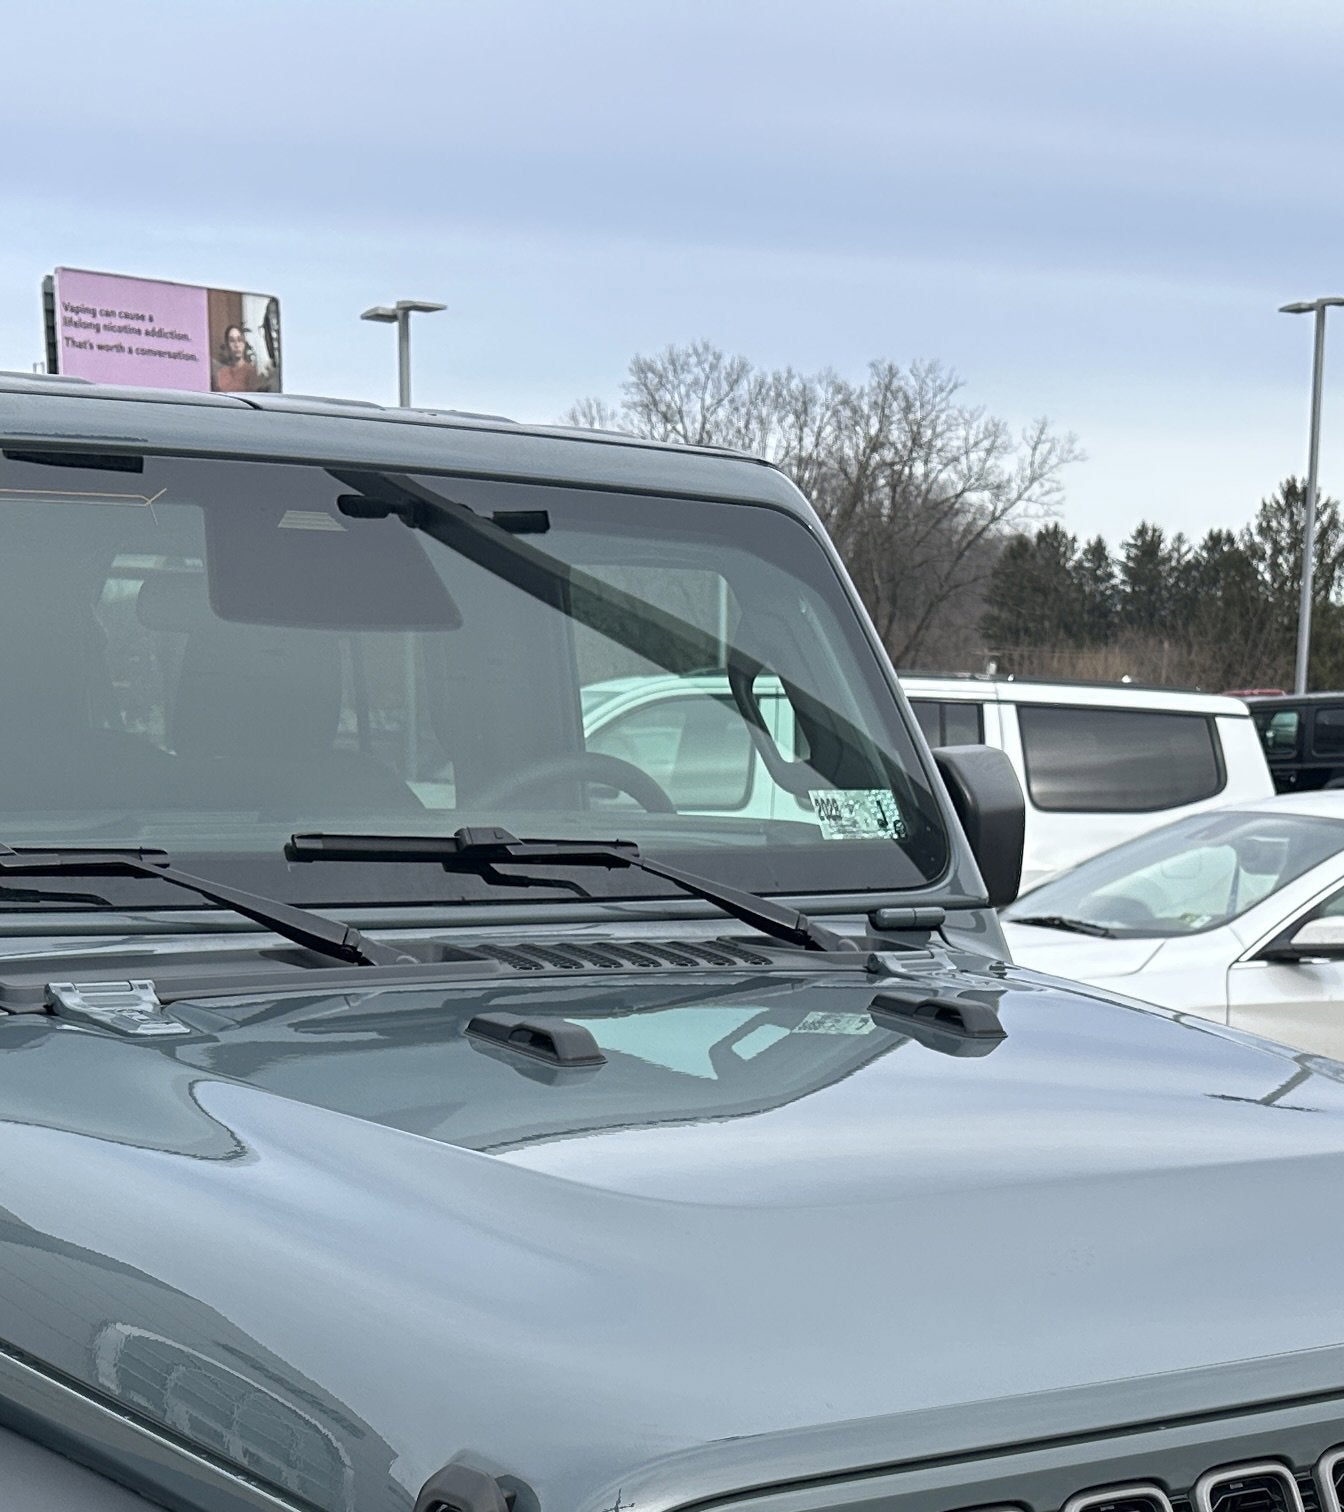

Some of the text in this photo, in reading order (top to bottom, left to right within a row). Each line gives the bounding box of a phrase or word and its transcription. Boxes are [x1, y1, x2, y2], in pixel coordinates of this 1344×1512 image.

[61, 301, 154, 323] Vaping can cause a
[62, 315, 192, 341] lifelong nicotine addiction.
[64, 336, 200, 362] That's worth a conversation.
